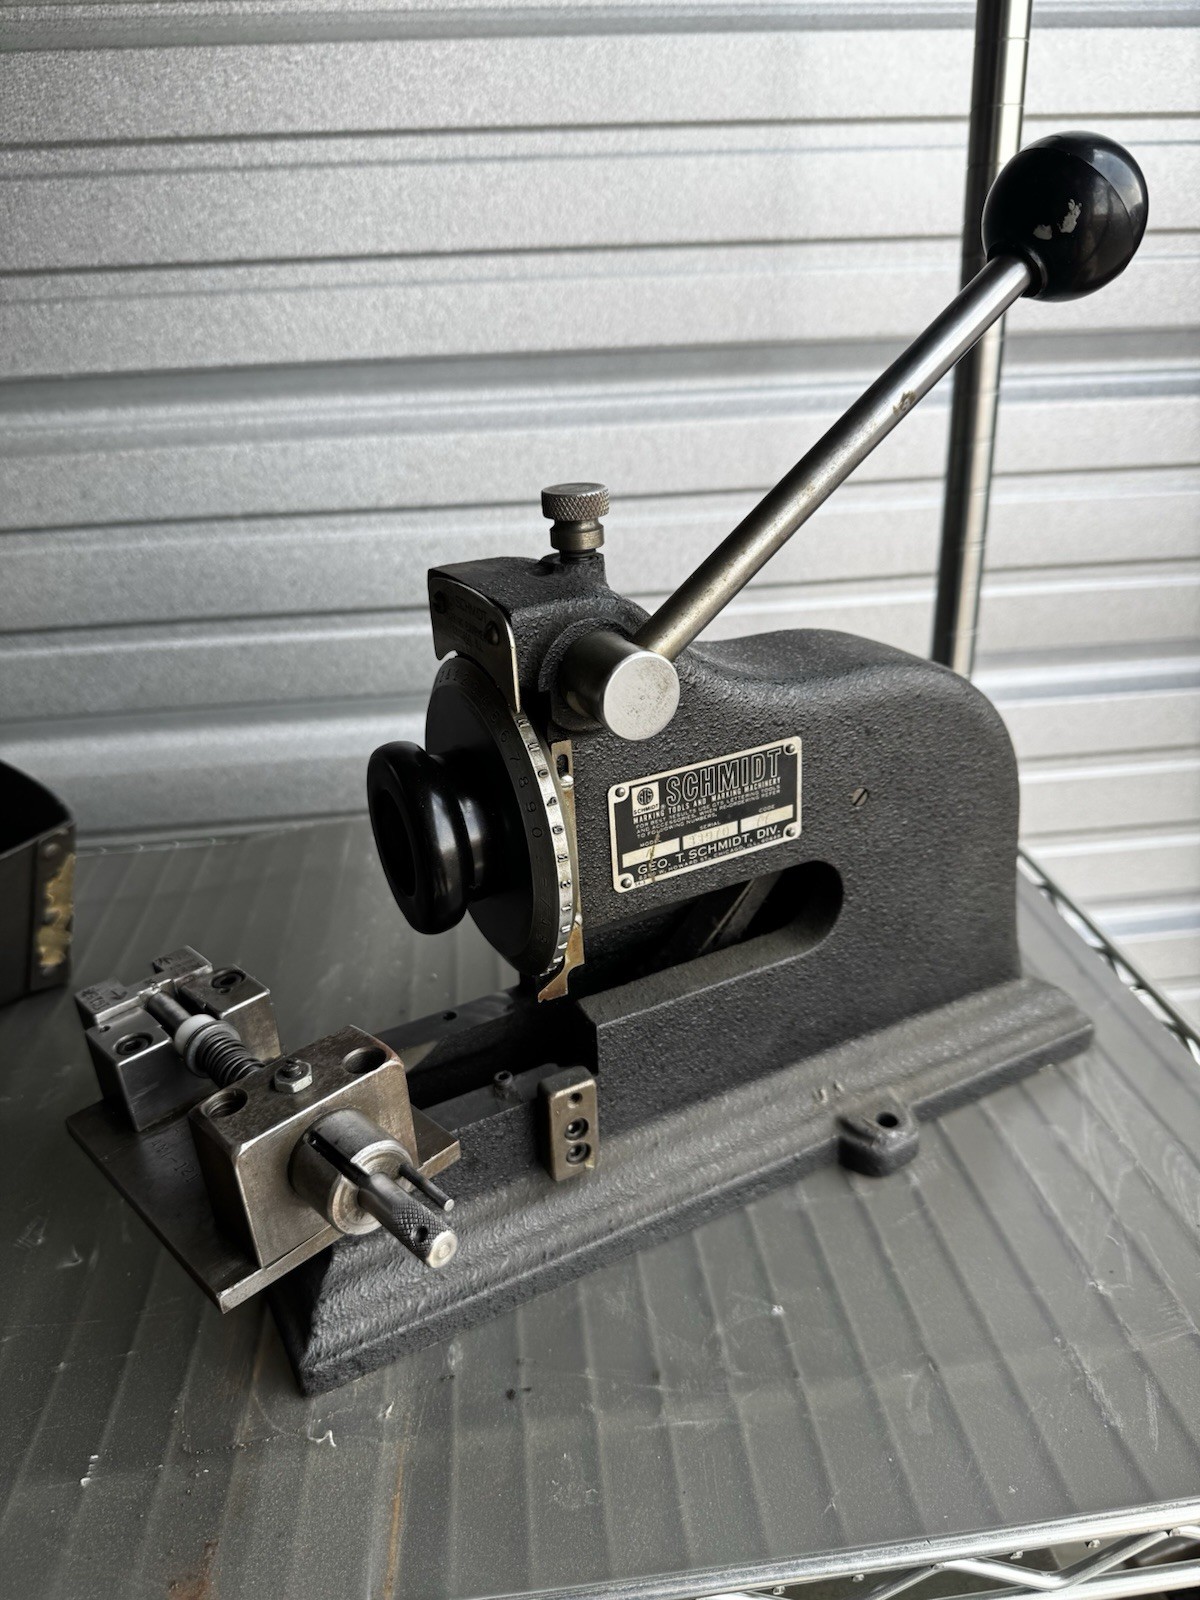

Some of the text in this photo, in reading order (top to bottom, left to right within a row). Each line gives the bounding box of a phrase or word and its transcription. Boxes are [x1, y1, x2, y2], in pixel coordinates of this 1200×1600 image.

[665, 747, 781, 807] SCHMIDT
[633, 776, 780, 824] MARKING TOOLS AND MARKING MACHINERY
[633, 803, 658, 814] SCHMIDT
[635, 821, 648, 829] FOR
[650, 816, 666, 825] BEST
[669, 808, 696, 819] RESULTS
[726, 790, 759, 803] LETTERING
[760, 784, 780, 793] TOOLS
[636, 826, 649, 834] AND
[699, 807, 717, 816] WHEN
[760, 789, 780, 798] REFER
[758, 803, 775, 813] CODE
[699, 820, 720, 830] SERIAL
[637, 856, 670, 875] GEO.
[675, 851, 685, 863] T.
[756, 823, 780, 839] DIV.
[668, 858, 697, 871] HOWARD
